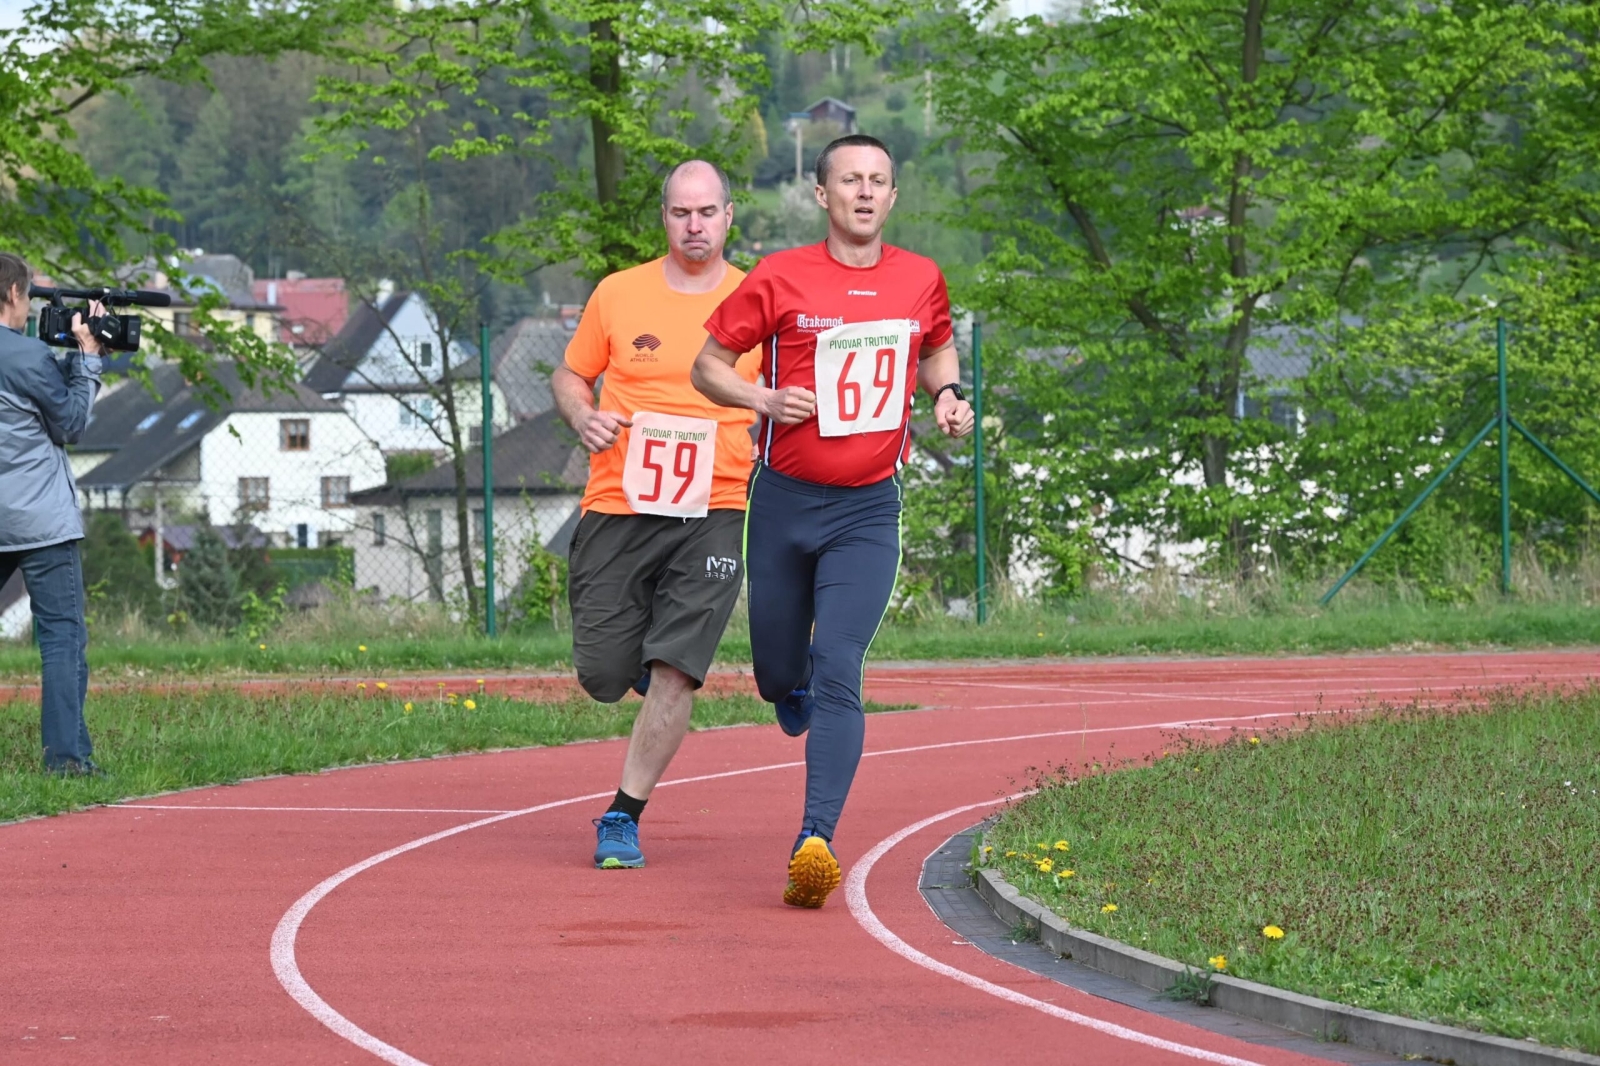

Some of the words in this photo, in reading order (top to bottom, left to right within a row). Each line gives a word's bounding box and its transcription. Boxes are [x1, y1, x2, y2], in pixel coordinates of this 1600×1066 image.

[829, 338, 863, 350] PIVOVAR
[864, 334, 899, 347] TRUTNOV
[837, 348, 896, 421] 69
[641, 427, 672, 439] PIVOVAR
[674, 430, 708, 441] TRUTNOV
[638, 439, 697, 504] 59
